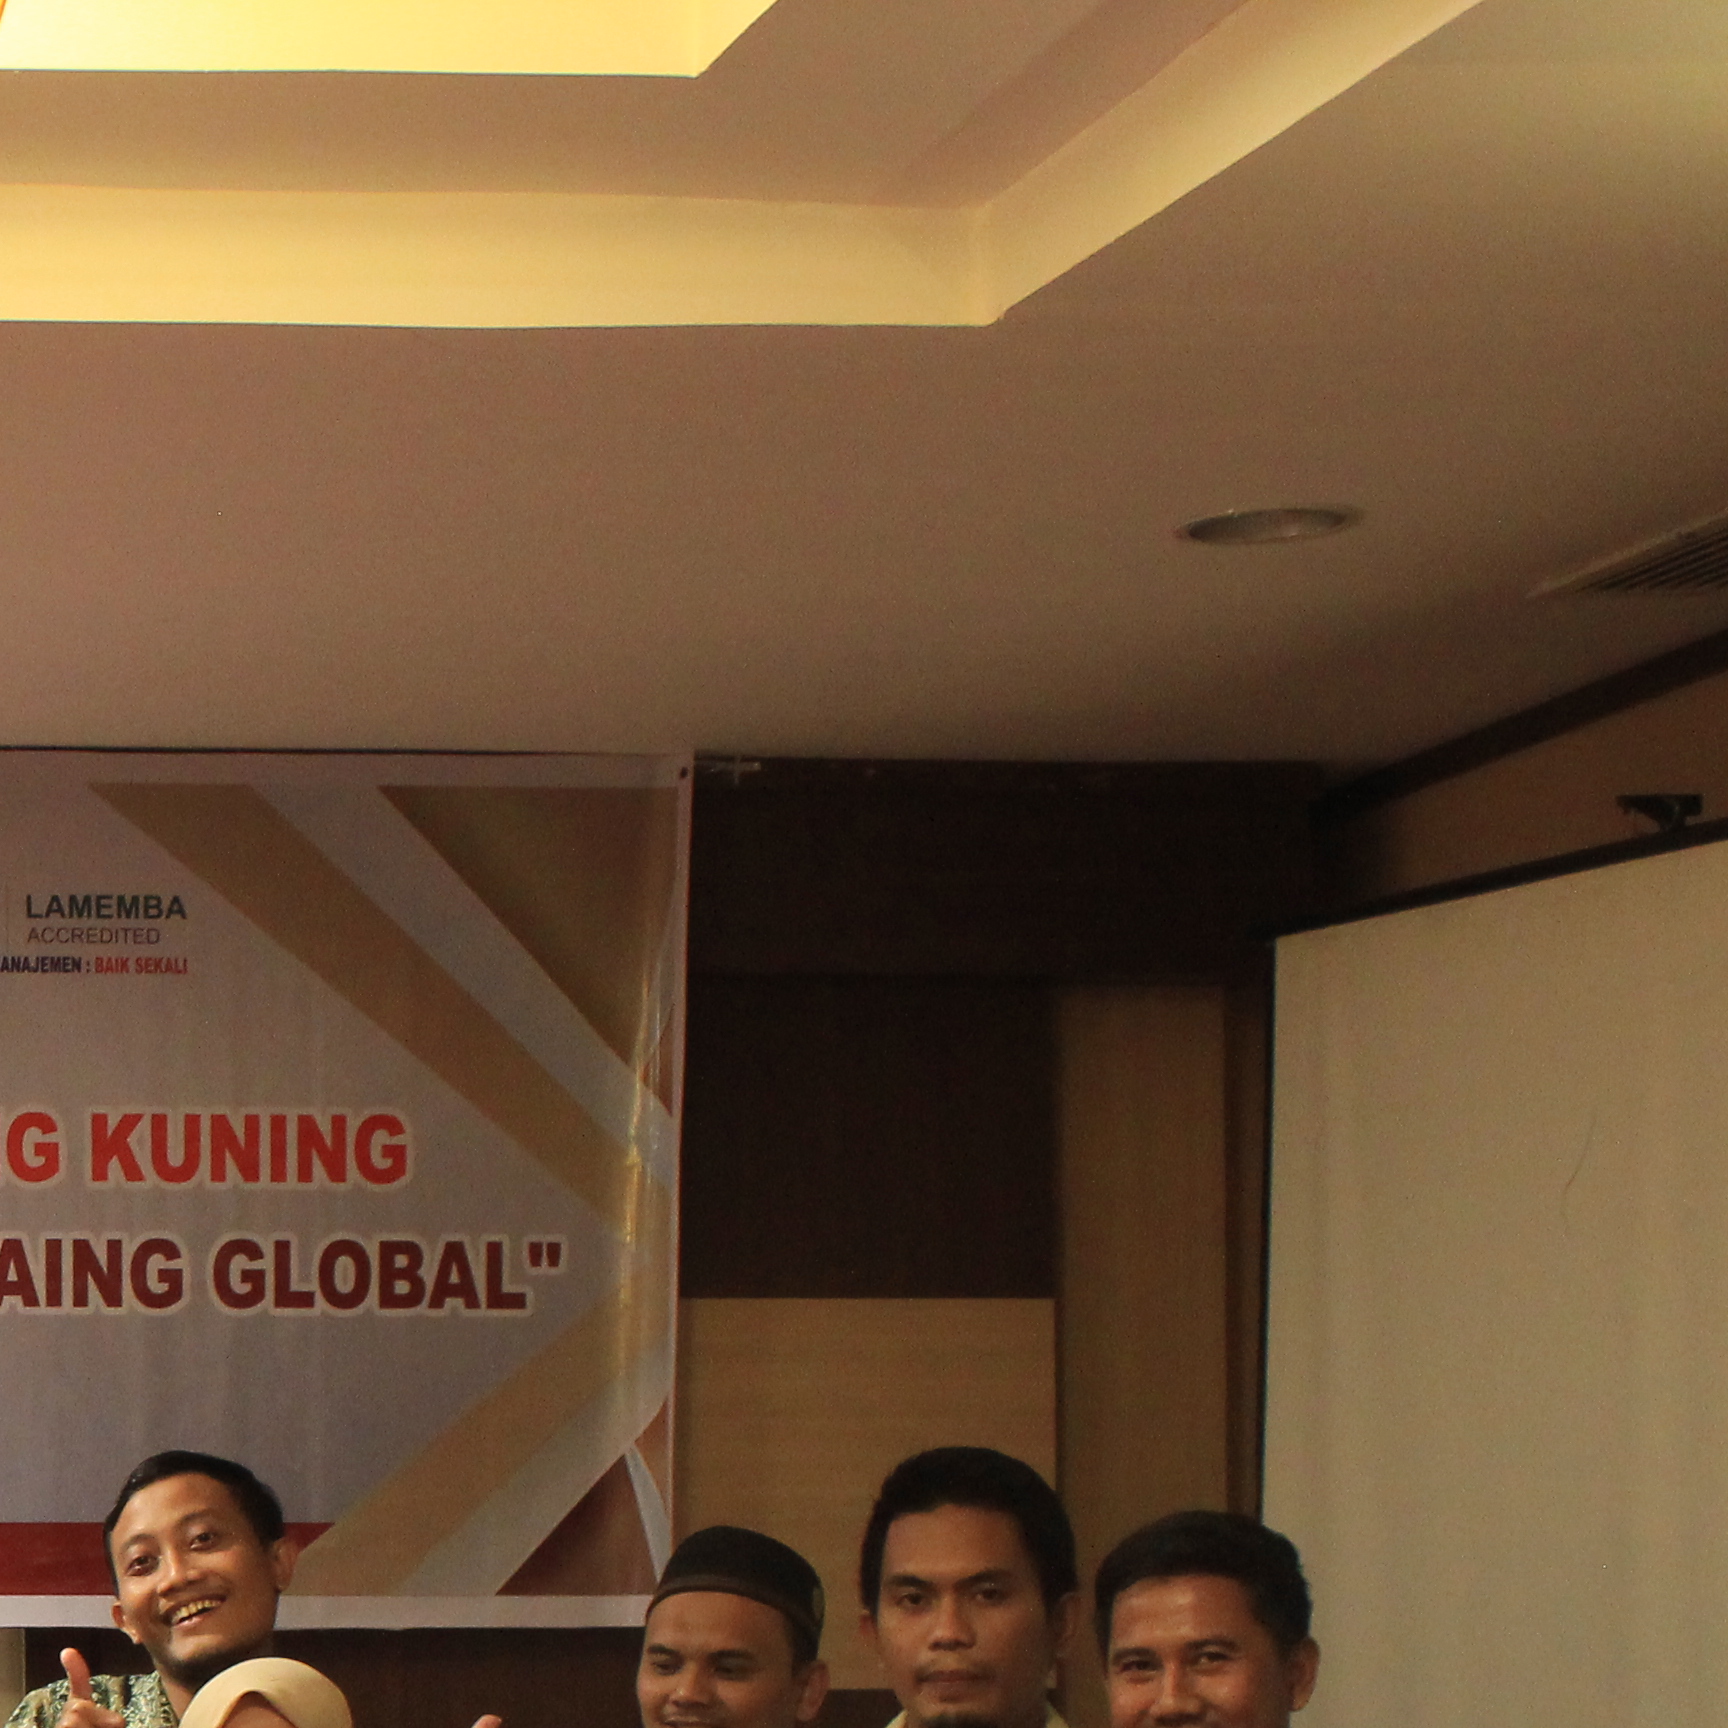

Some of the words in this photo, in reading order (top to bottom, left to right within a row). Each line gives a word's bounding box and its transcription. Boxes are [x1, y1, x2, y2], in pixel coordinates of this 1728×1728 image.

[26, 894, 188, 919] LAMEMBA
[27, 926, 161, 945] ACCREDITED
[94, 956, 131, 974] BAIK
[135, 957, 189, 975] SEKALI
[91, 1113, 408, 1184] KUNING
[211, 1238, 564, 1311] GLOBAL"
